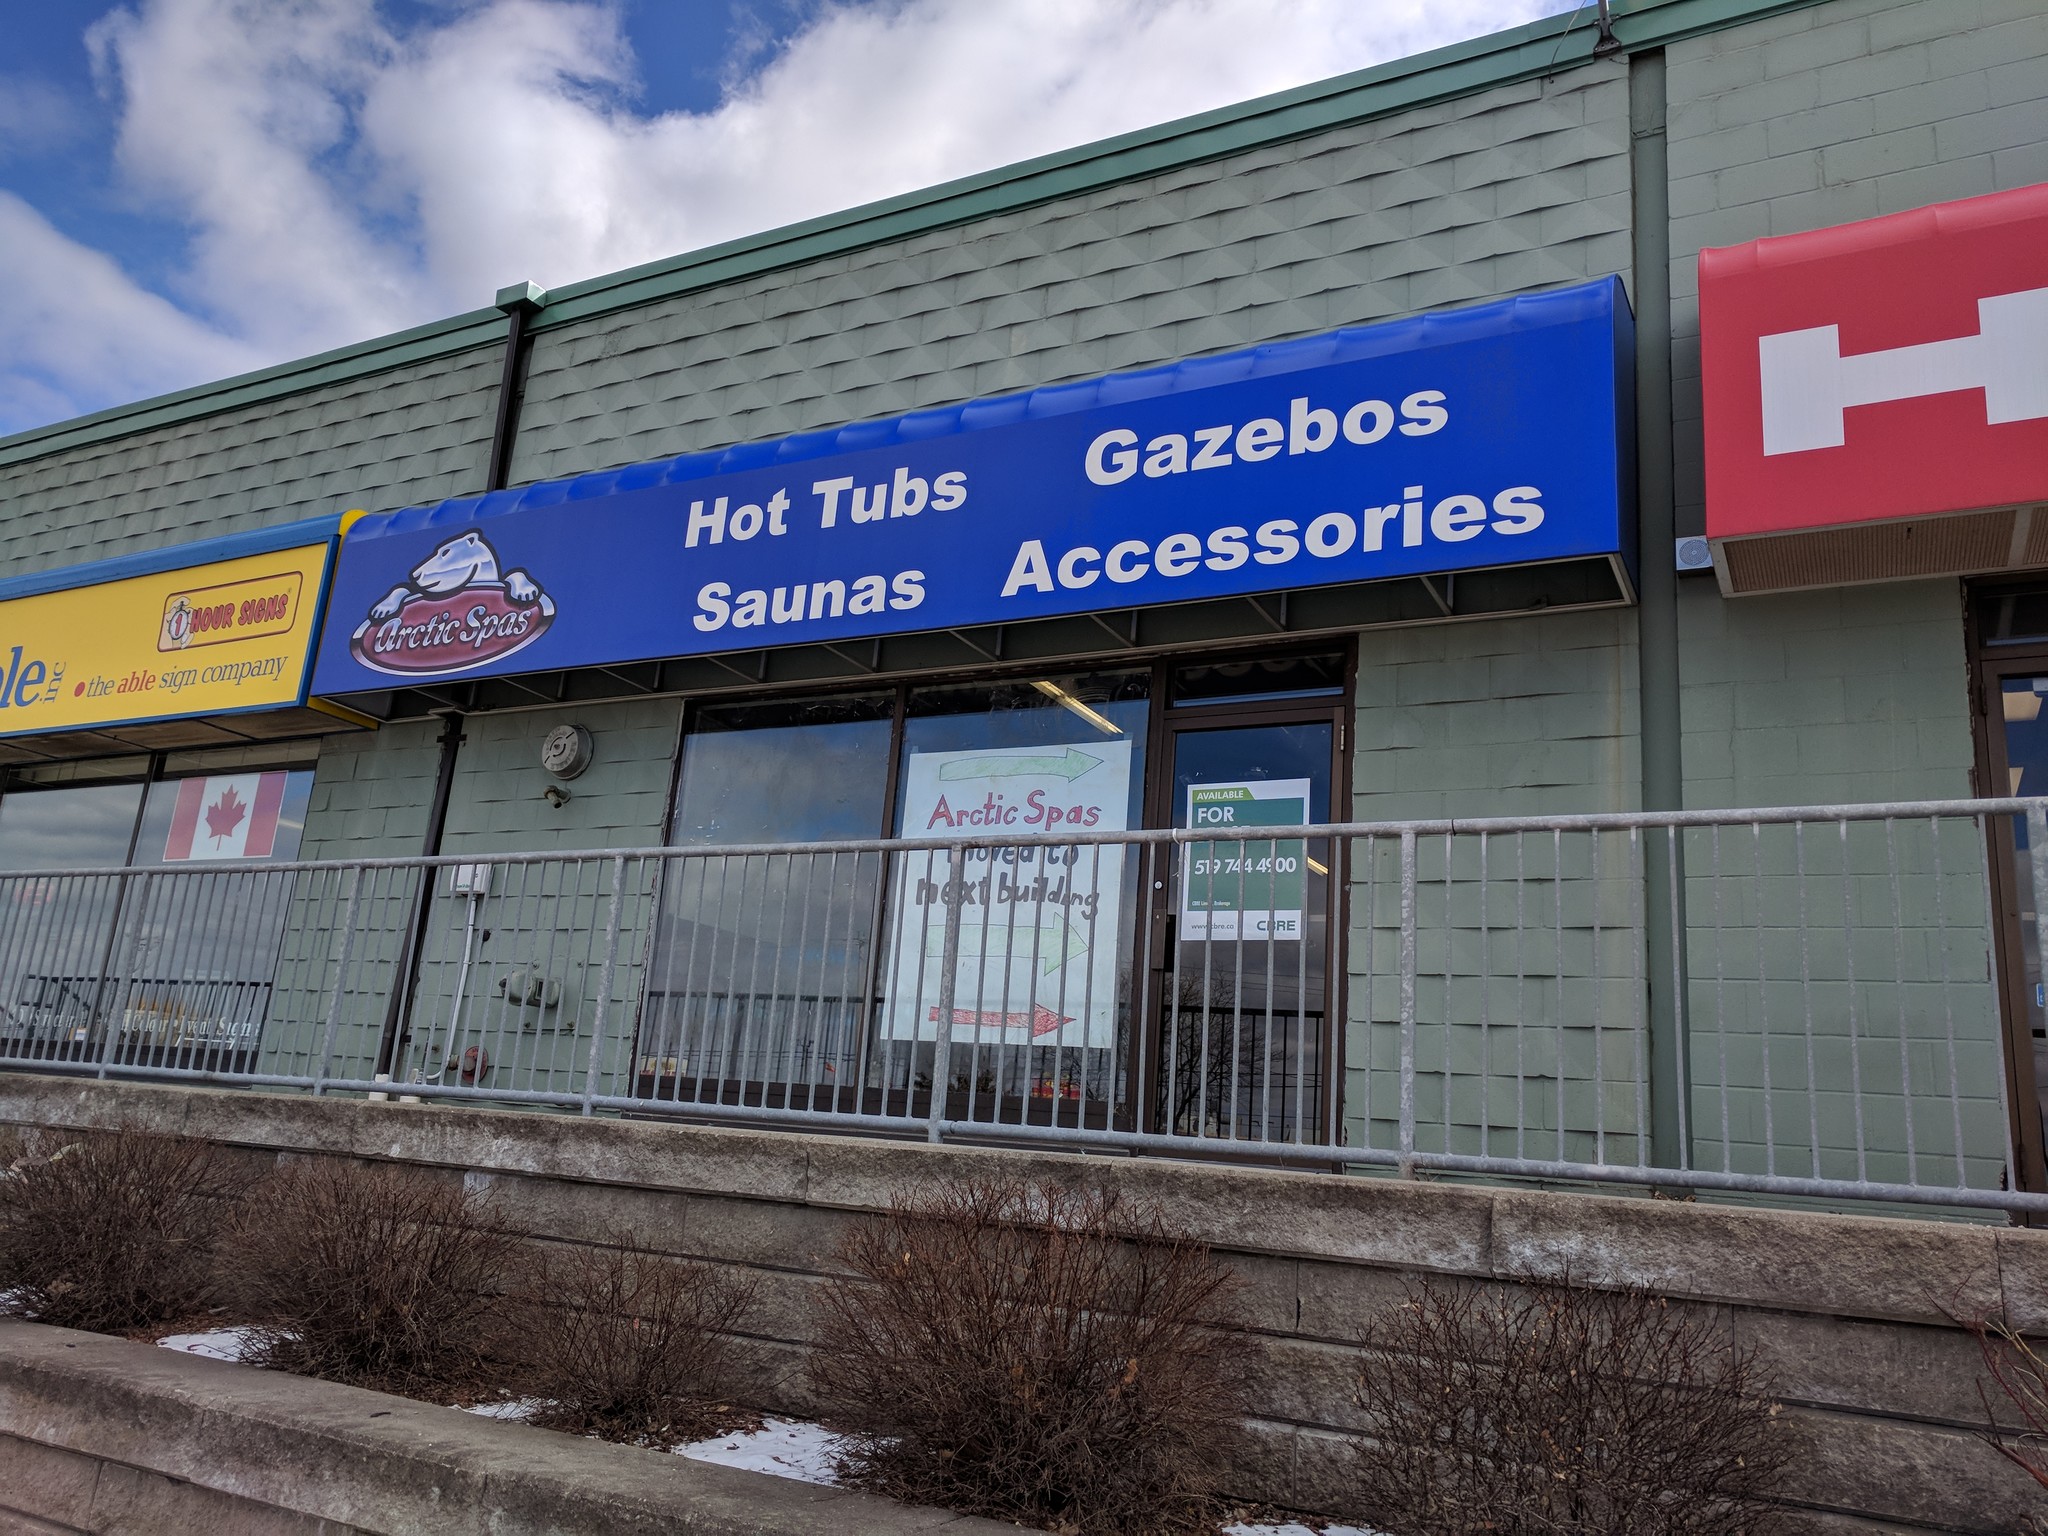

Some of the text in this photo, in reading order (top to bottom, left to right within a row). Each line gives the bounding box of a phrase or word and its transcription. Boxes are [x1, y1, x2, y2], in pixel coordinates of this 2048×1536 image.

[1084, 389, 1449, 486] Gazebos
[684, 466, 968, 548] Hot Tubs
[1000, 485, 1546, 598] Accessories
[189, 602, 236, 634] HOUR
[238, 593, 289, 626] SIGNS
[692, 569, 926, 632] Saunas
[460, 605, 532, 649] Spas
[0, 645, 46, 708] le
[86, 656, 289, 698] the able sign company
[927, 789, 1103, 831] Arctic Spas
[1196, 790, 1244, 801] AVAILABLE
[1197, 806, 1235, 824] FOR
[1194, 856, 1297, 875] 519 744 4900
